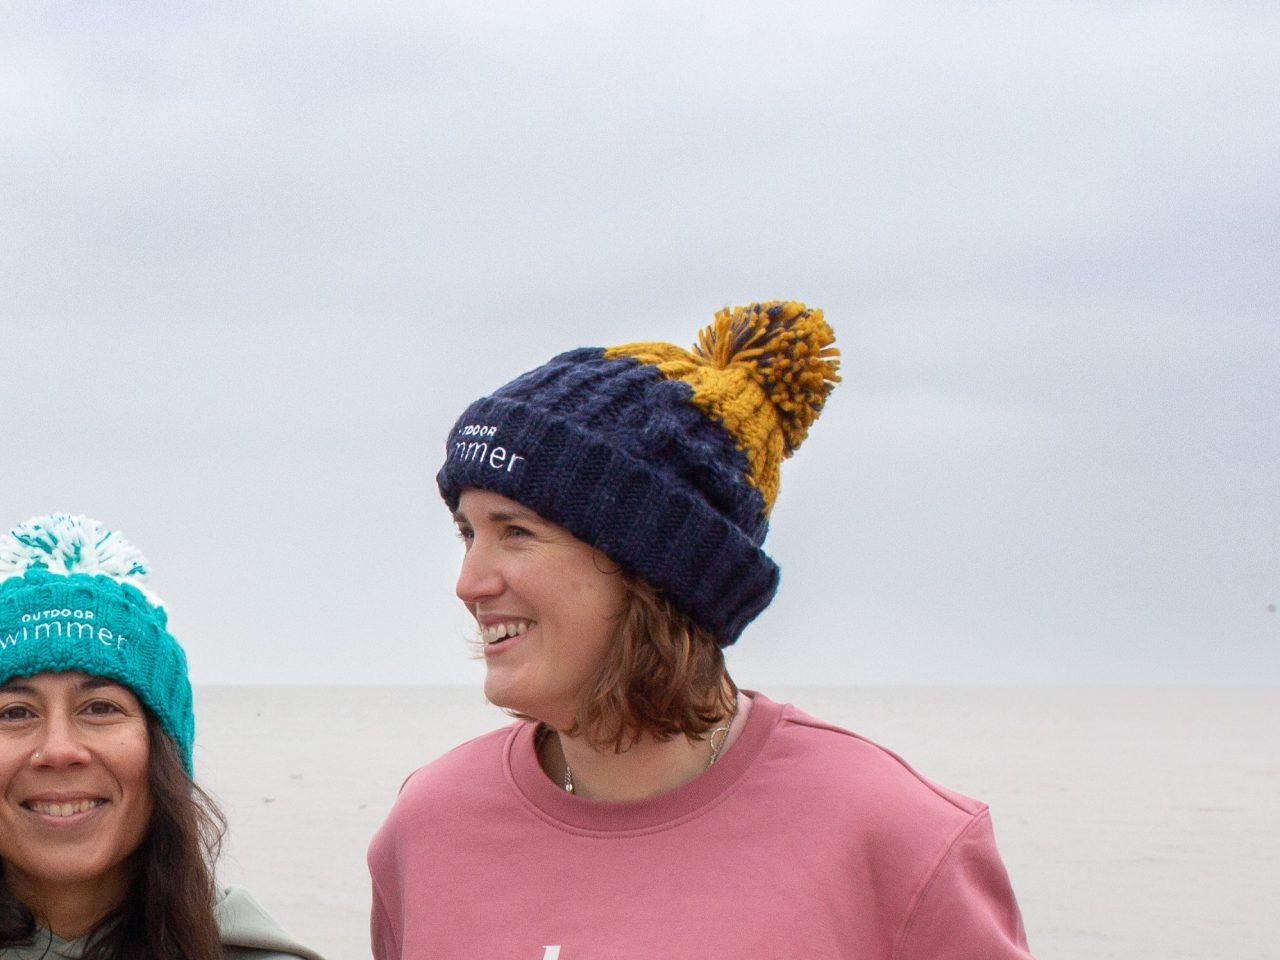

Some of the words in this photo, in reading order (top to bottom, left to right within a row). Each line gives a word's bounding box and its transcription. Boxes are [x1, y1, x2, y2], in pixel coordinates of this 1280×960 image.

[458, 425, 497, 437] TDOOR
[455, 441, 525, 473] mmer
[21, 608, 95, 622] OUTDOOR
